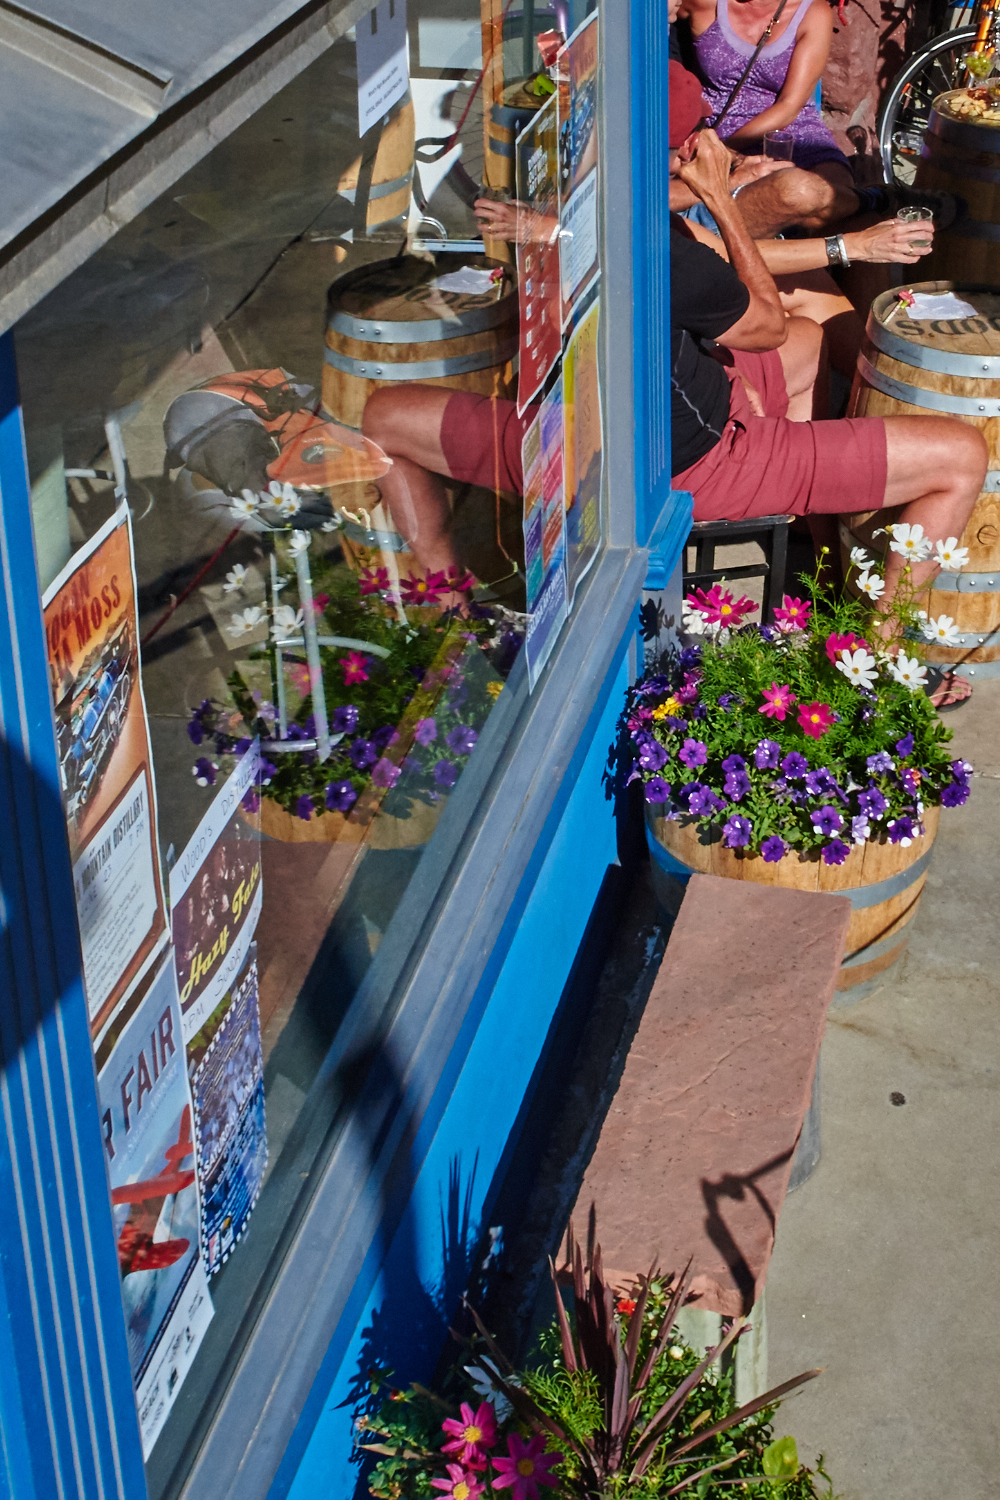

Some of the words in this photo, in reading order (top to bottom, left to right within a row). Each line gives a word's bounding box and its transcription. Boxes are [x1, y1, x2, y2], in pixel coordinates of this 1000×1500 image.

[74, 574, 121, 650] MOSS
[180, 825, 213, 883] WOOD'S
[179, 924, 230, 1004] Hazy
[120, 1005, 177, 1137] FAIR
